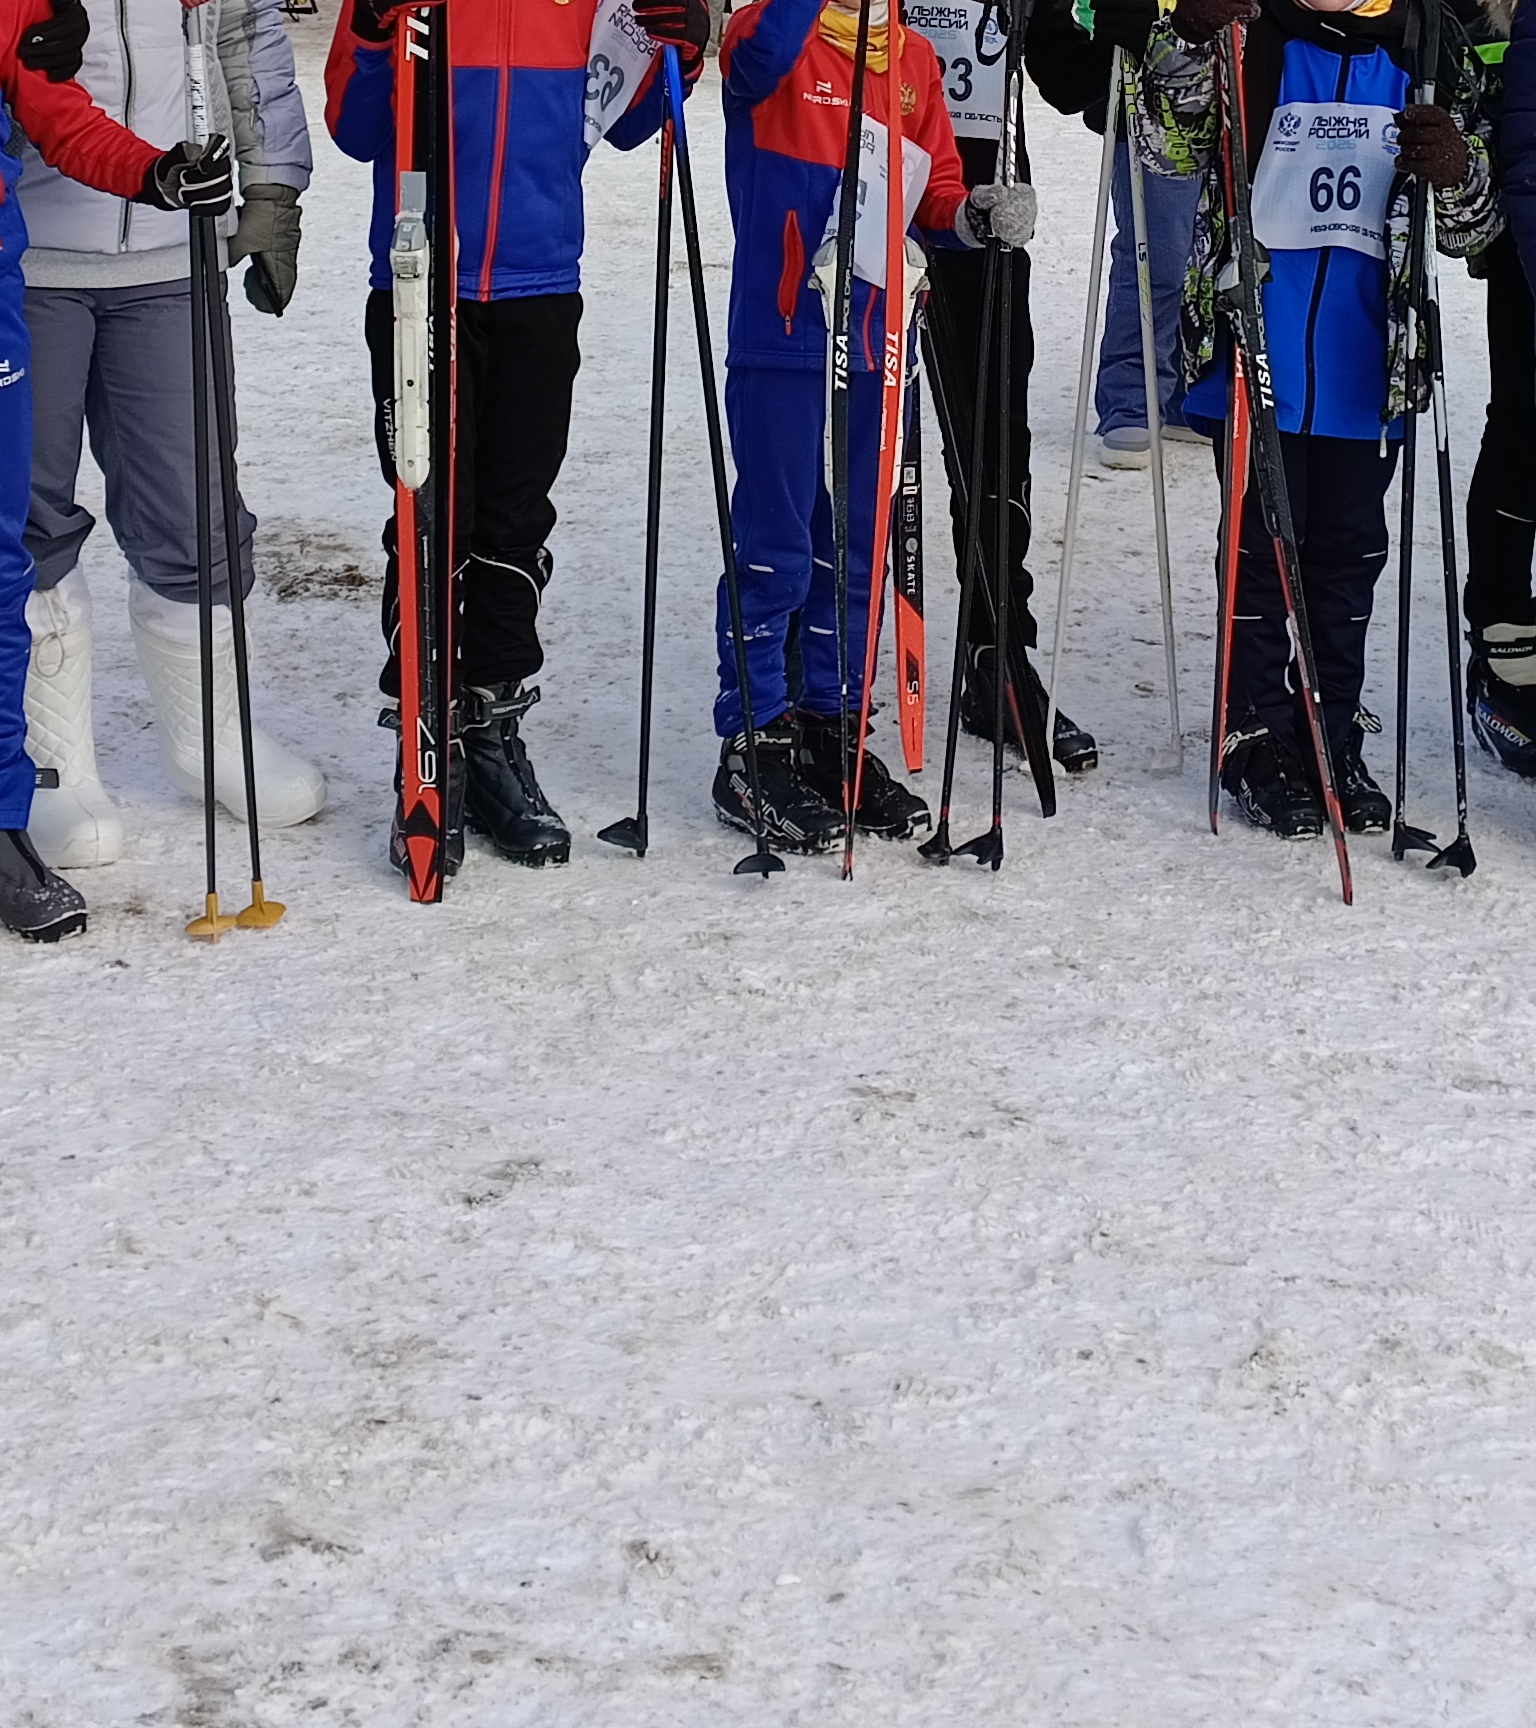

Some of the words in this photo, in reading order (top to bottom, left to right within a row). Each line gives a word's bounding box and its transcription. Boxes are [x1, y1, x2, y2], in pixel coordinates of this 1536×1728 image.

[907, 16, 968, 31] РОССИИ
[911, 5, 967, 19] ЛЫЖНЯ
[1308, 127, 1370, 139] РОССИИ
[1313, 115, 1368, 128] ЛЫЖНЯ
[1309, 165, 1362, 213] 66
[834, 334, 849, 391] TISA
[884, 331, 899, 387] TISA
[1255, 353, 1274, 409] TISA
[906, 554, 916, 595] SKATE
[415, 716, 437, 795] 167
